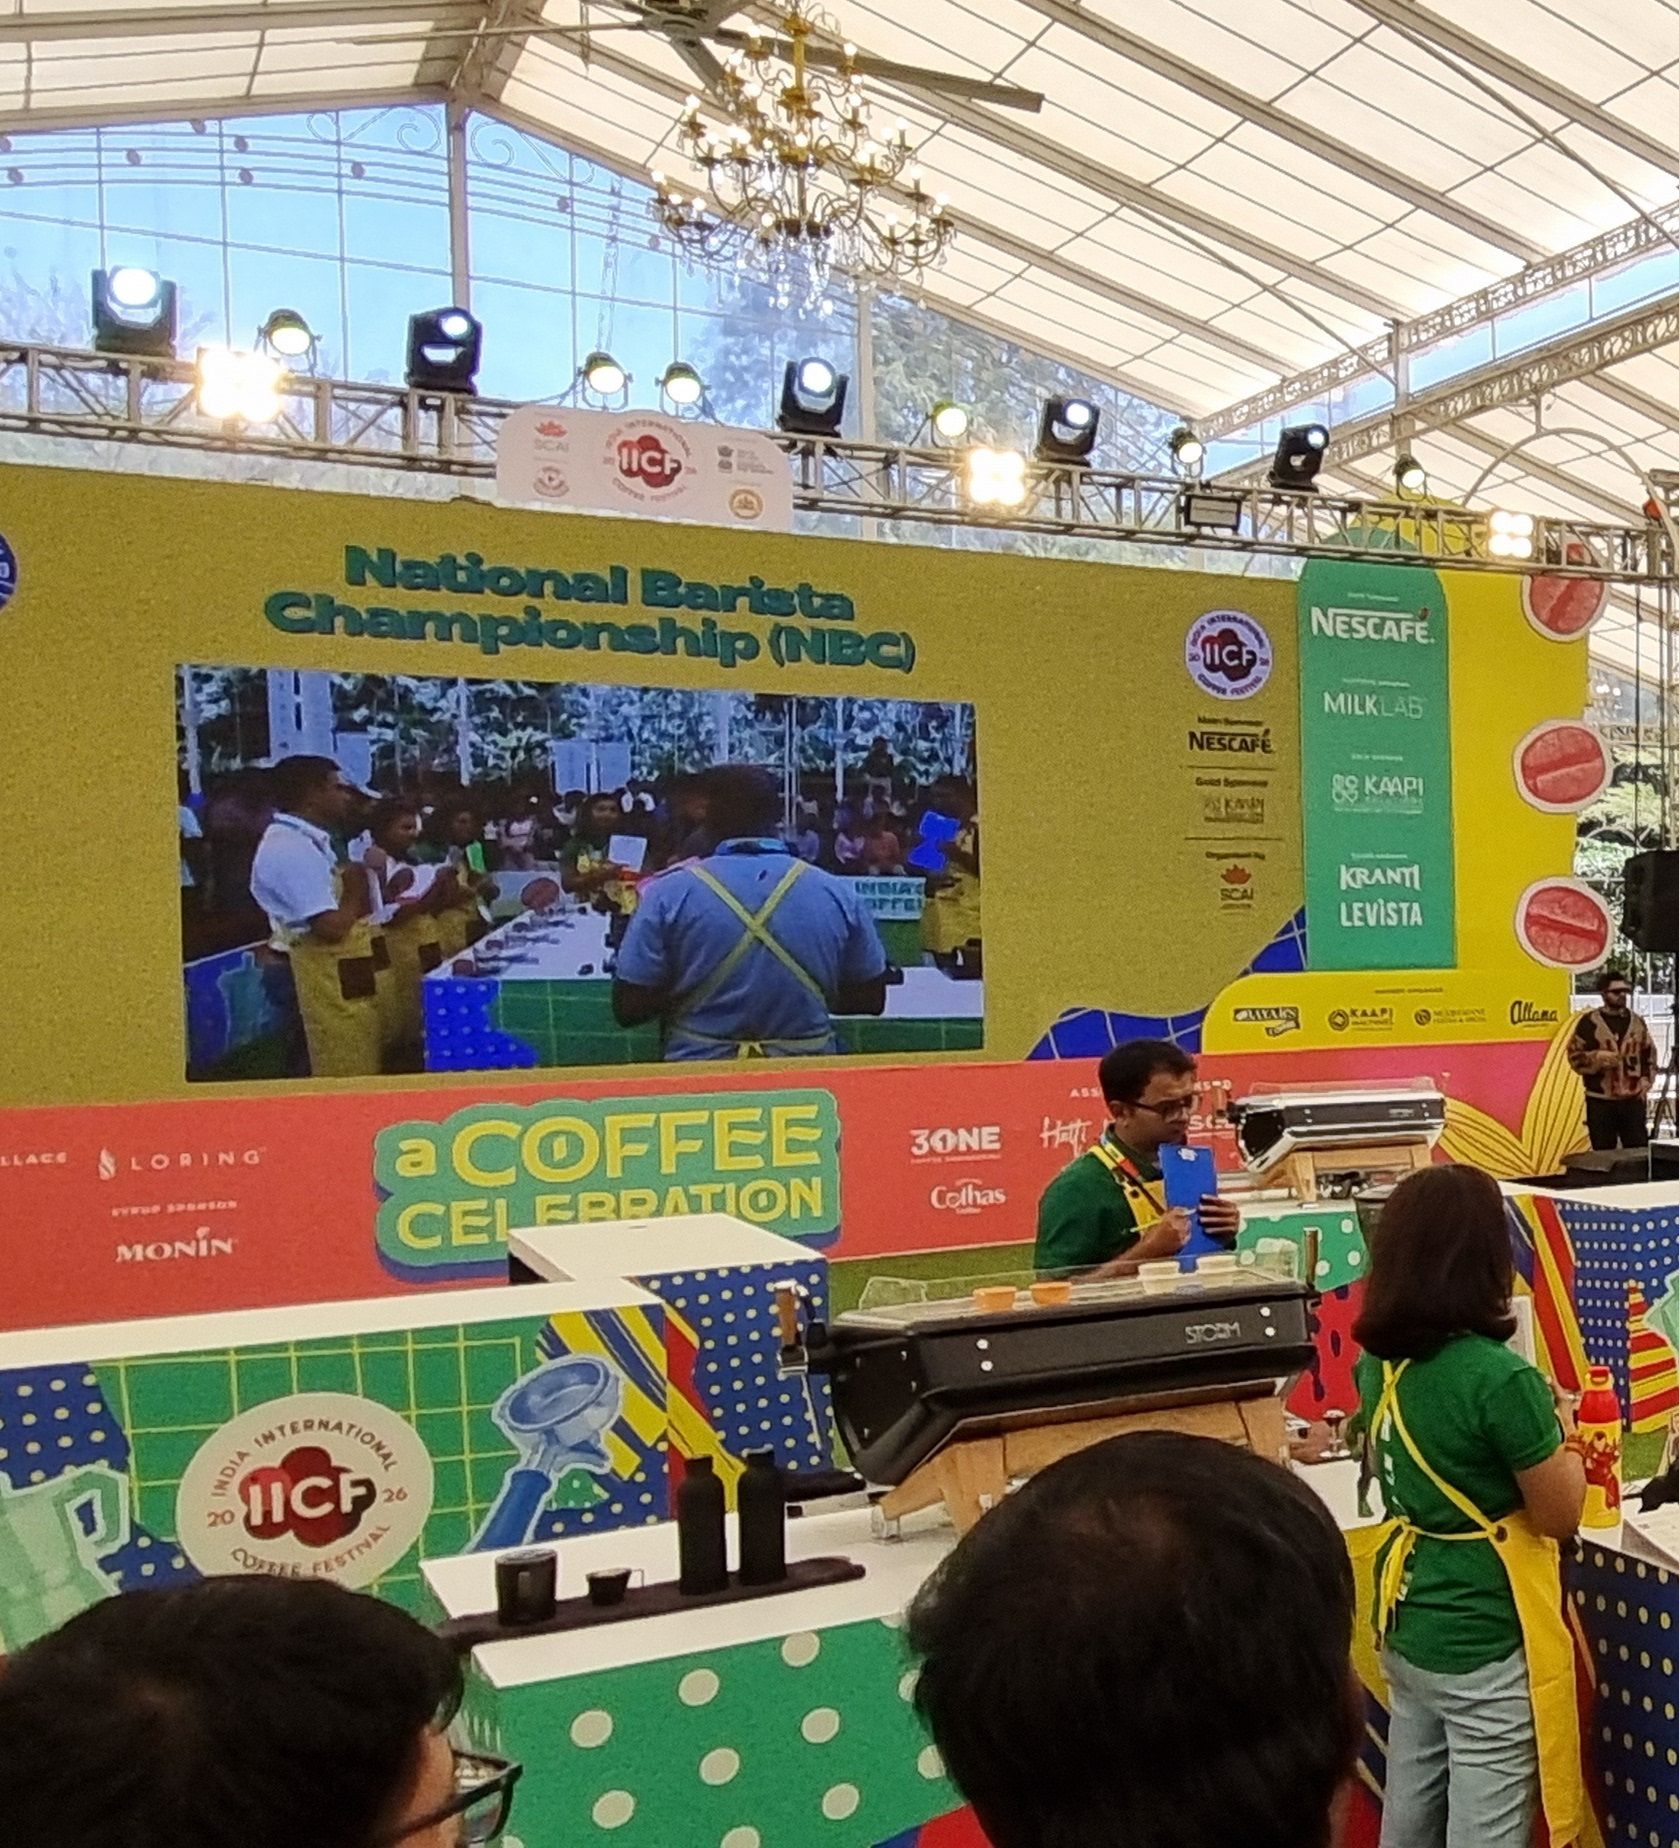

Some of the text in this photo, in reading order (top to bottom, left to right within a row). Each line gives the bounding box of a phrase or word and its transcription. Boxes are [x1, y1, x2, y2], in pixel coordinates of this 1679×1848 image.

[344, 545, 855, 621] National Barista
[264, 590, 916, 673] Championship (NBC)
[1205, 643, 1253, 667] IICF
[1365, 775, 1424, 797] KAAPI
[1339, 864, 1421, 891] KRANTI
[1340, 898, 1423, 927] LEVISTA
[394, 1102, 823, 1188] a COFFEE
[130, 1149, 260, 1171] LORING
[1185, 1321, 1241, 1344] STORM
[211, 1418, 398, 1498] INDIA INTERNATIONAL
[249, 1472, 368, 1526] IICF
[382, 1487, 408, 1503] 26
[207, 1510, 235, 1528] 20
[312, 1523, 391, 1575] FESTIVAL
